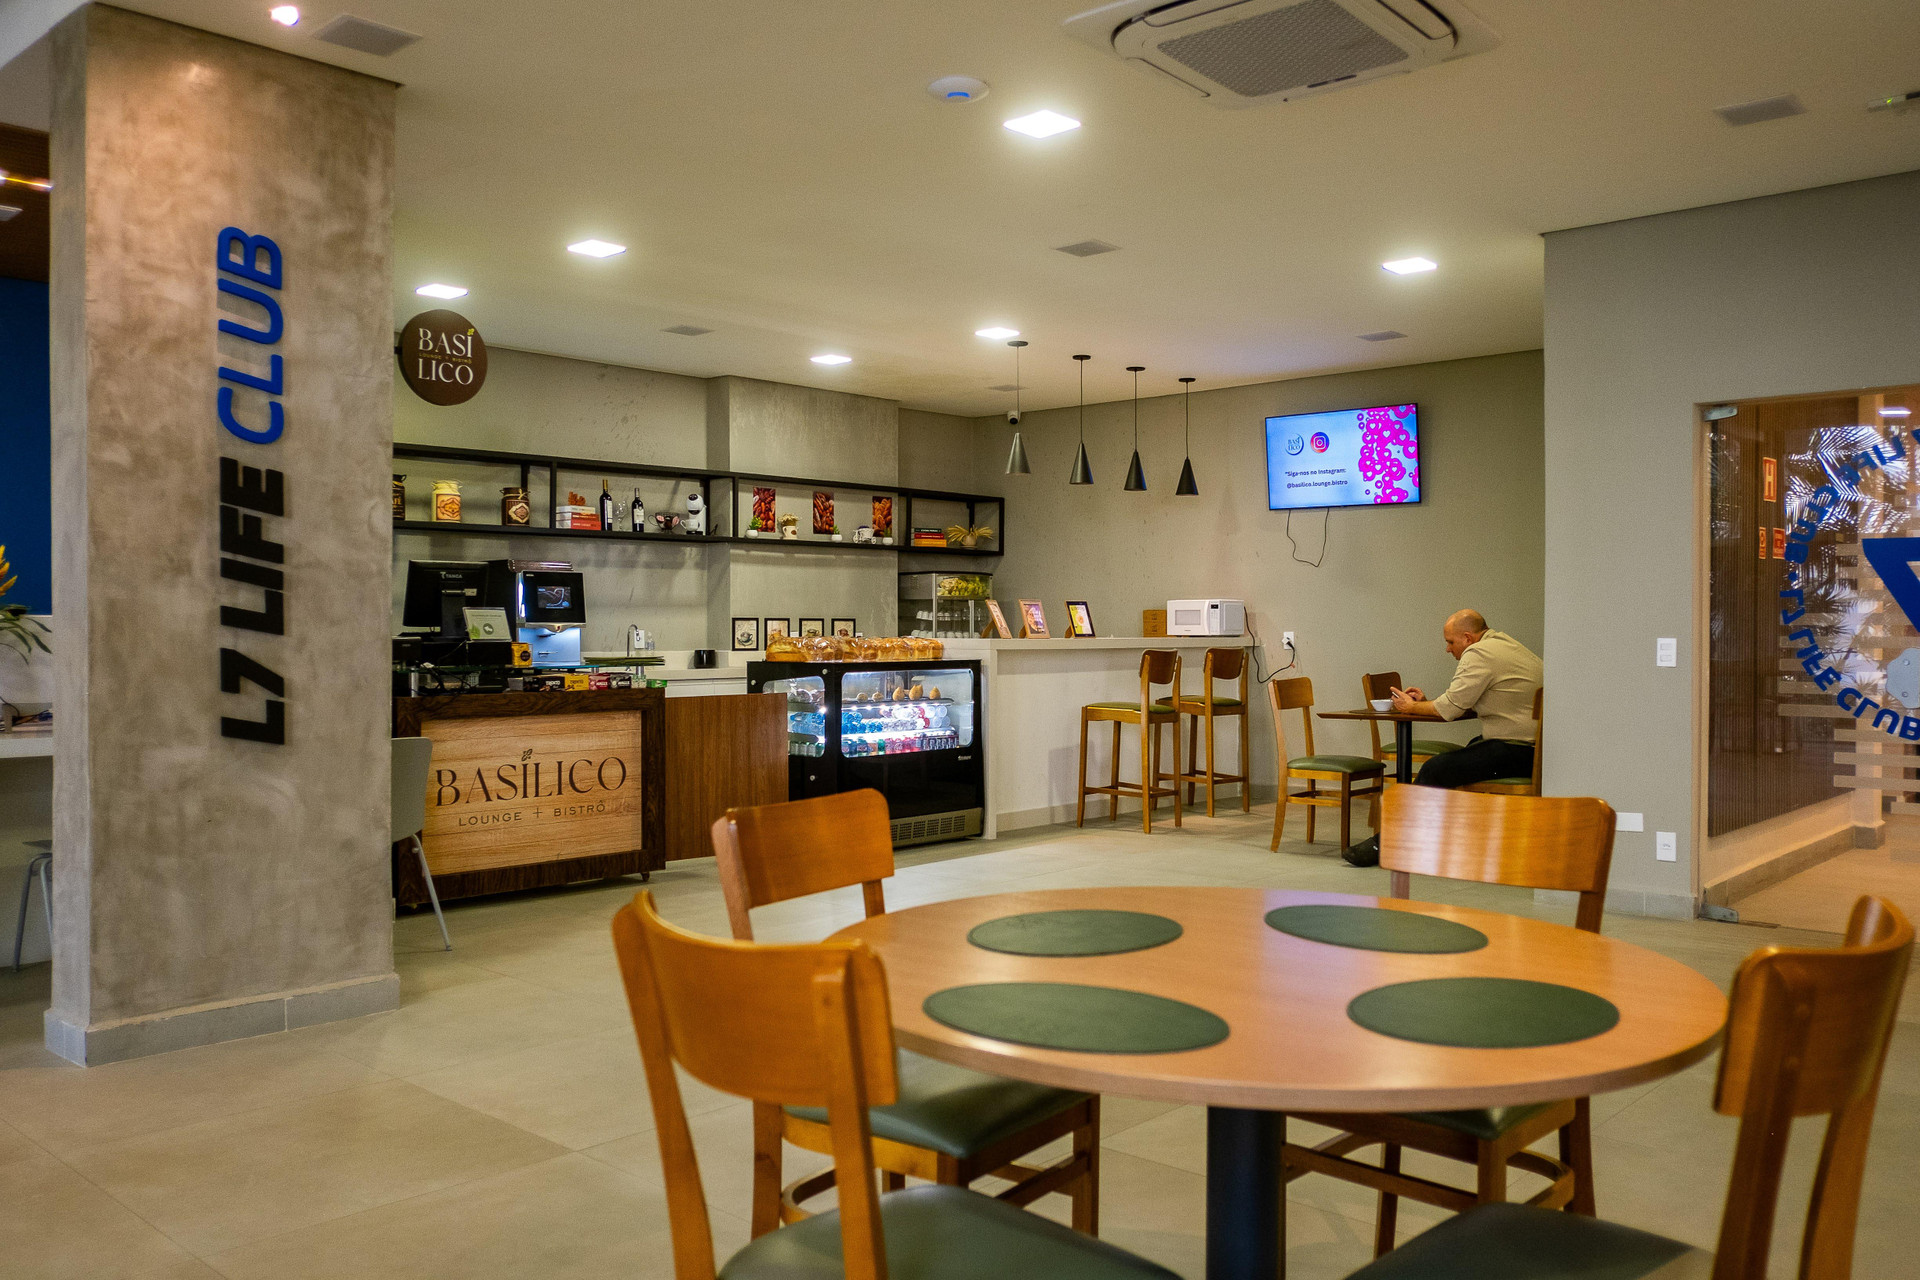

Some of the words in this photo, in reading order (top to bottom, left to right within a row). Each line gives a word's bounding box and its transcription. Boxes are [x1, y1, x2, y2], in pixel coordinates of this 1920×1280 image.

[217, 226, 284, 444] CLUB
[418, 358, 474, 385] LICO
[1287, 480, 1348, 488] @basilico.lounge.bistro
[219, 456, 284, 635] LIFE
[220, 647, 285, 745] L7
[458, 811, 523, 827] LOUNGE
[553, 800, 606, 817] BISTRÔ
